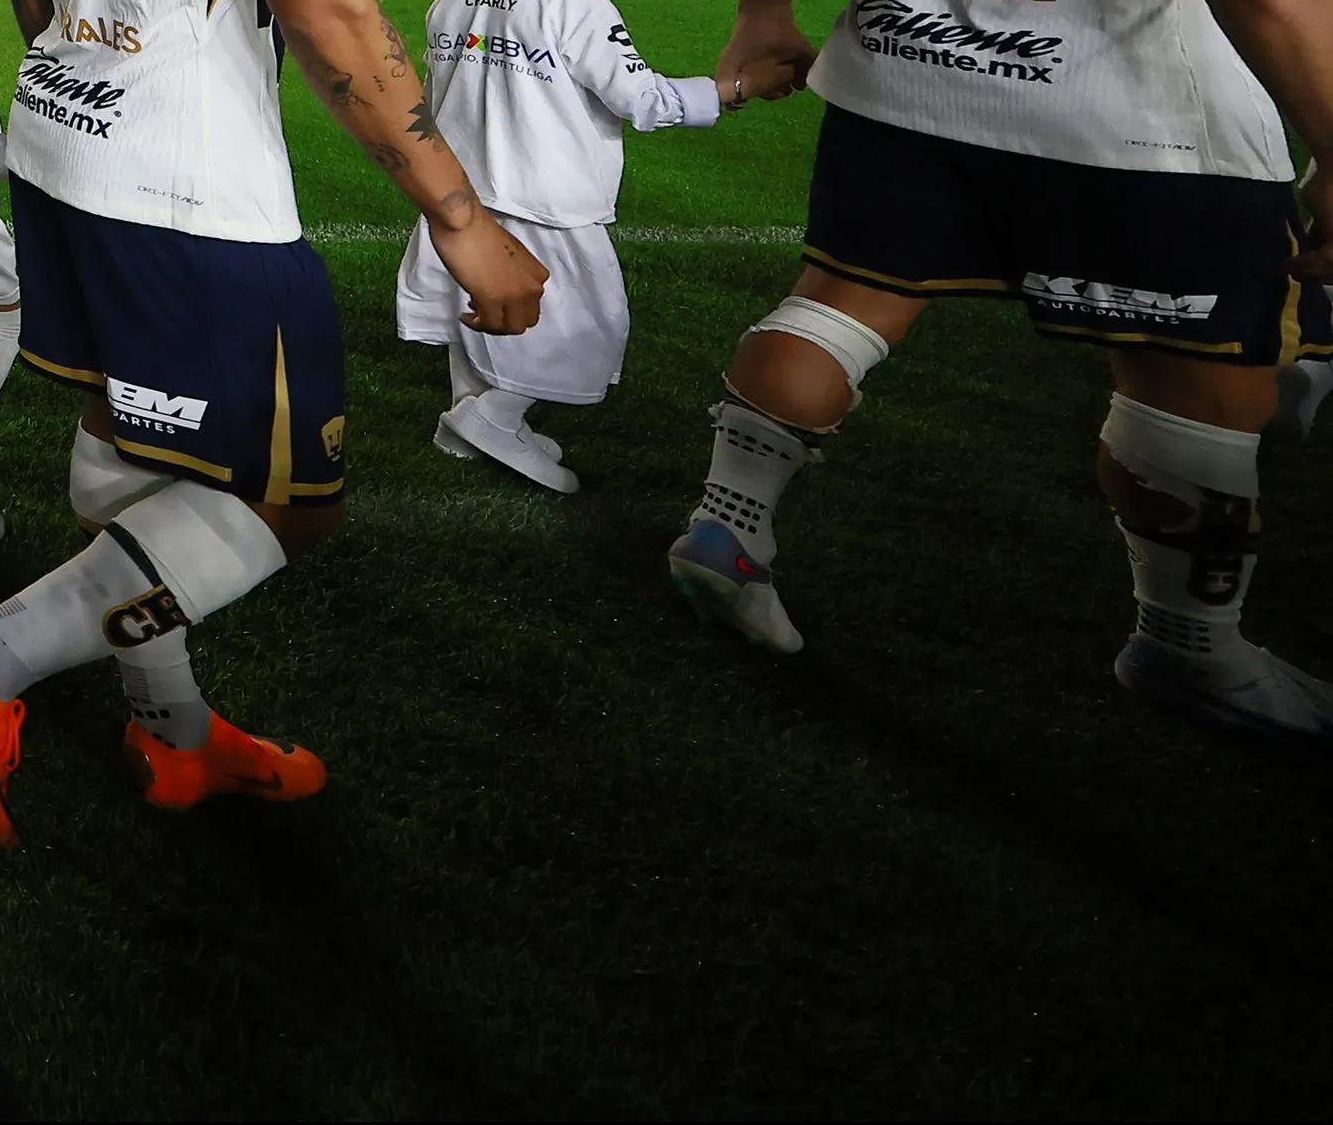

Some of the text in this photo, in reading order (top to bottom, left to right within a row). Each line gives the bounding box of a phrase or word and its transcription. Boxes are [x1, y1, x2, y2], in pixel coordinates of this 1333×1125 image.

[429, 32, 557, 69] LIGA BBVA
[861, 34, 1054, 84] caliente.mx
